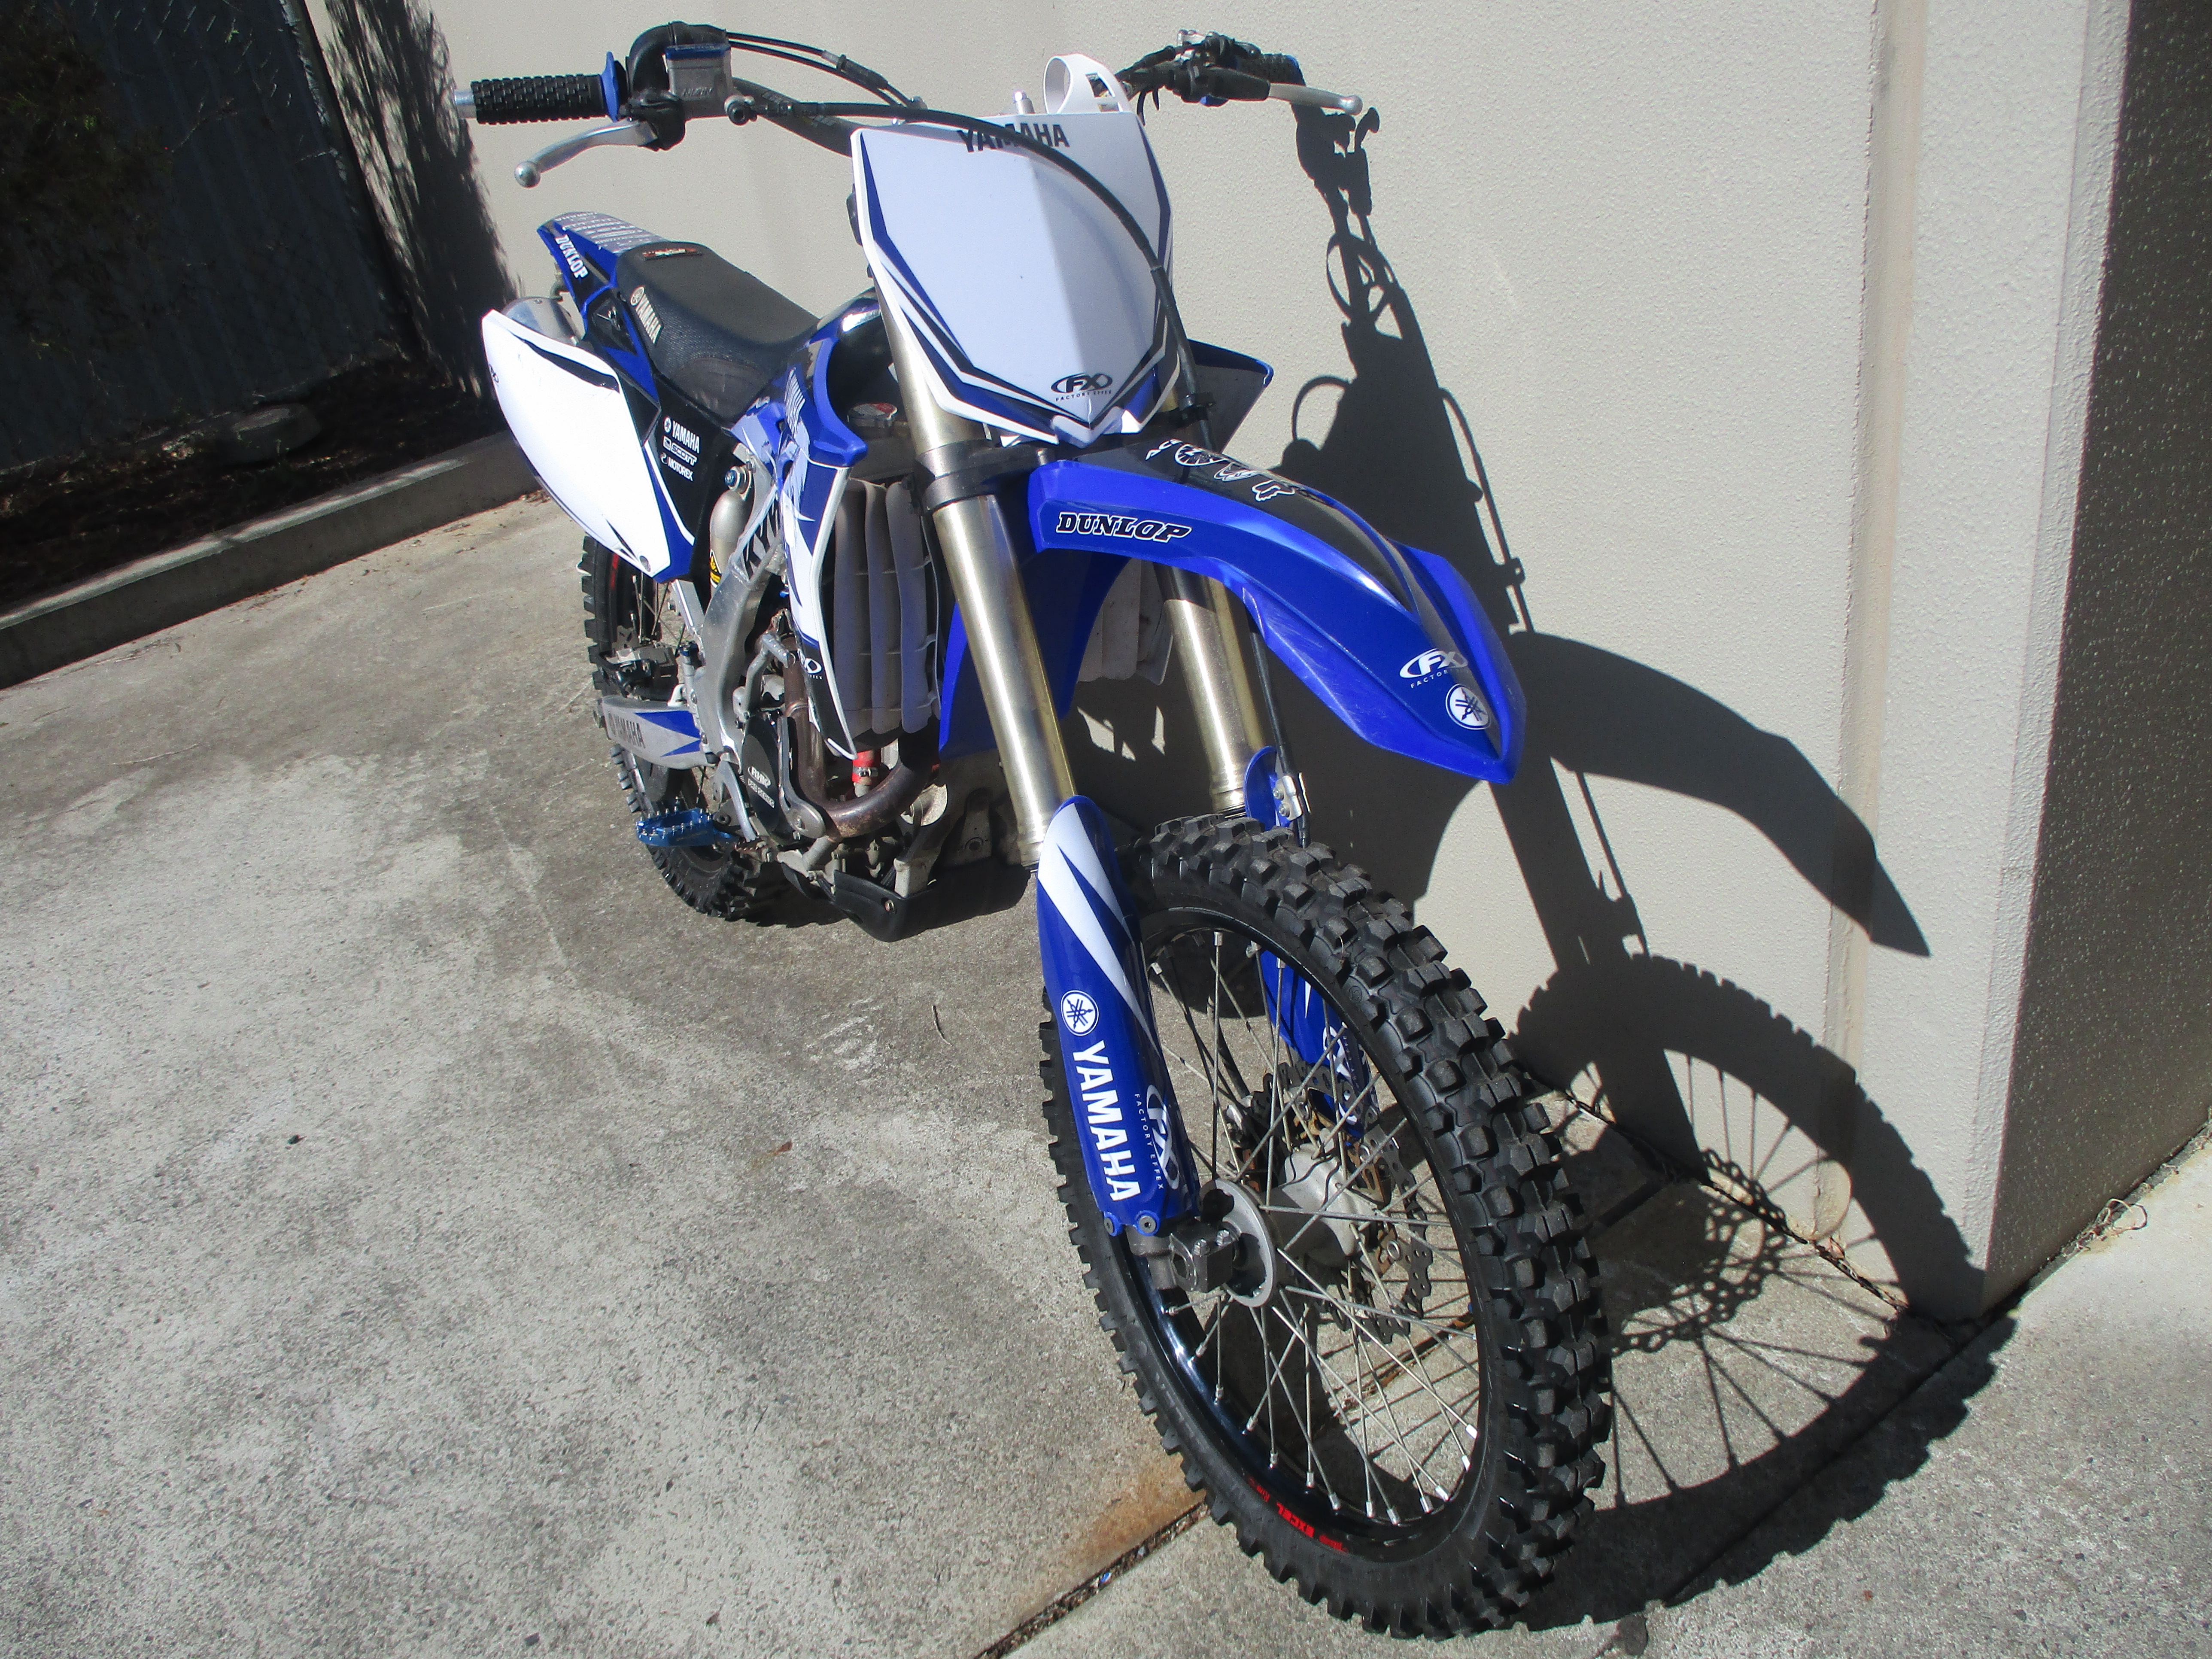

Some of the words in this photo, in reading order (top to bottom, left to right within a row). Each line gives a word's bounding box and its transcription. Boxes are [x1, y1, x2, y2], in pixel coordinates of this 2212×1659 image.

[555, 234, 588, 278] DUNLOP
[635, 294, 661, 343] YAMAHA
[1055, 392, 1090, 402] FACTORY
[671, 442, 697, 466] SCOTT
[672, 420, 700, 454] YAMAHA
[668, 456, 693, 481] MOTOREX
[1056, 512, 1192, 543] DUNLOP
[1073, 1040, 1141, 1201] YAMAHA
[1135, 1094, 1153, 1146] FACTORY
[1150, 1154, 1164, 1190] EFFEX
